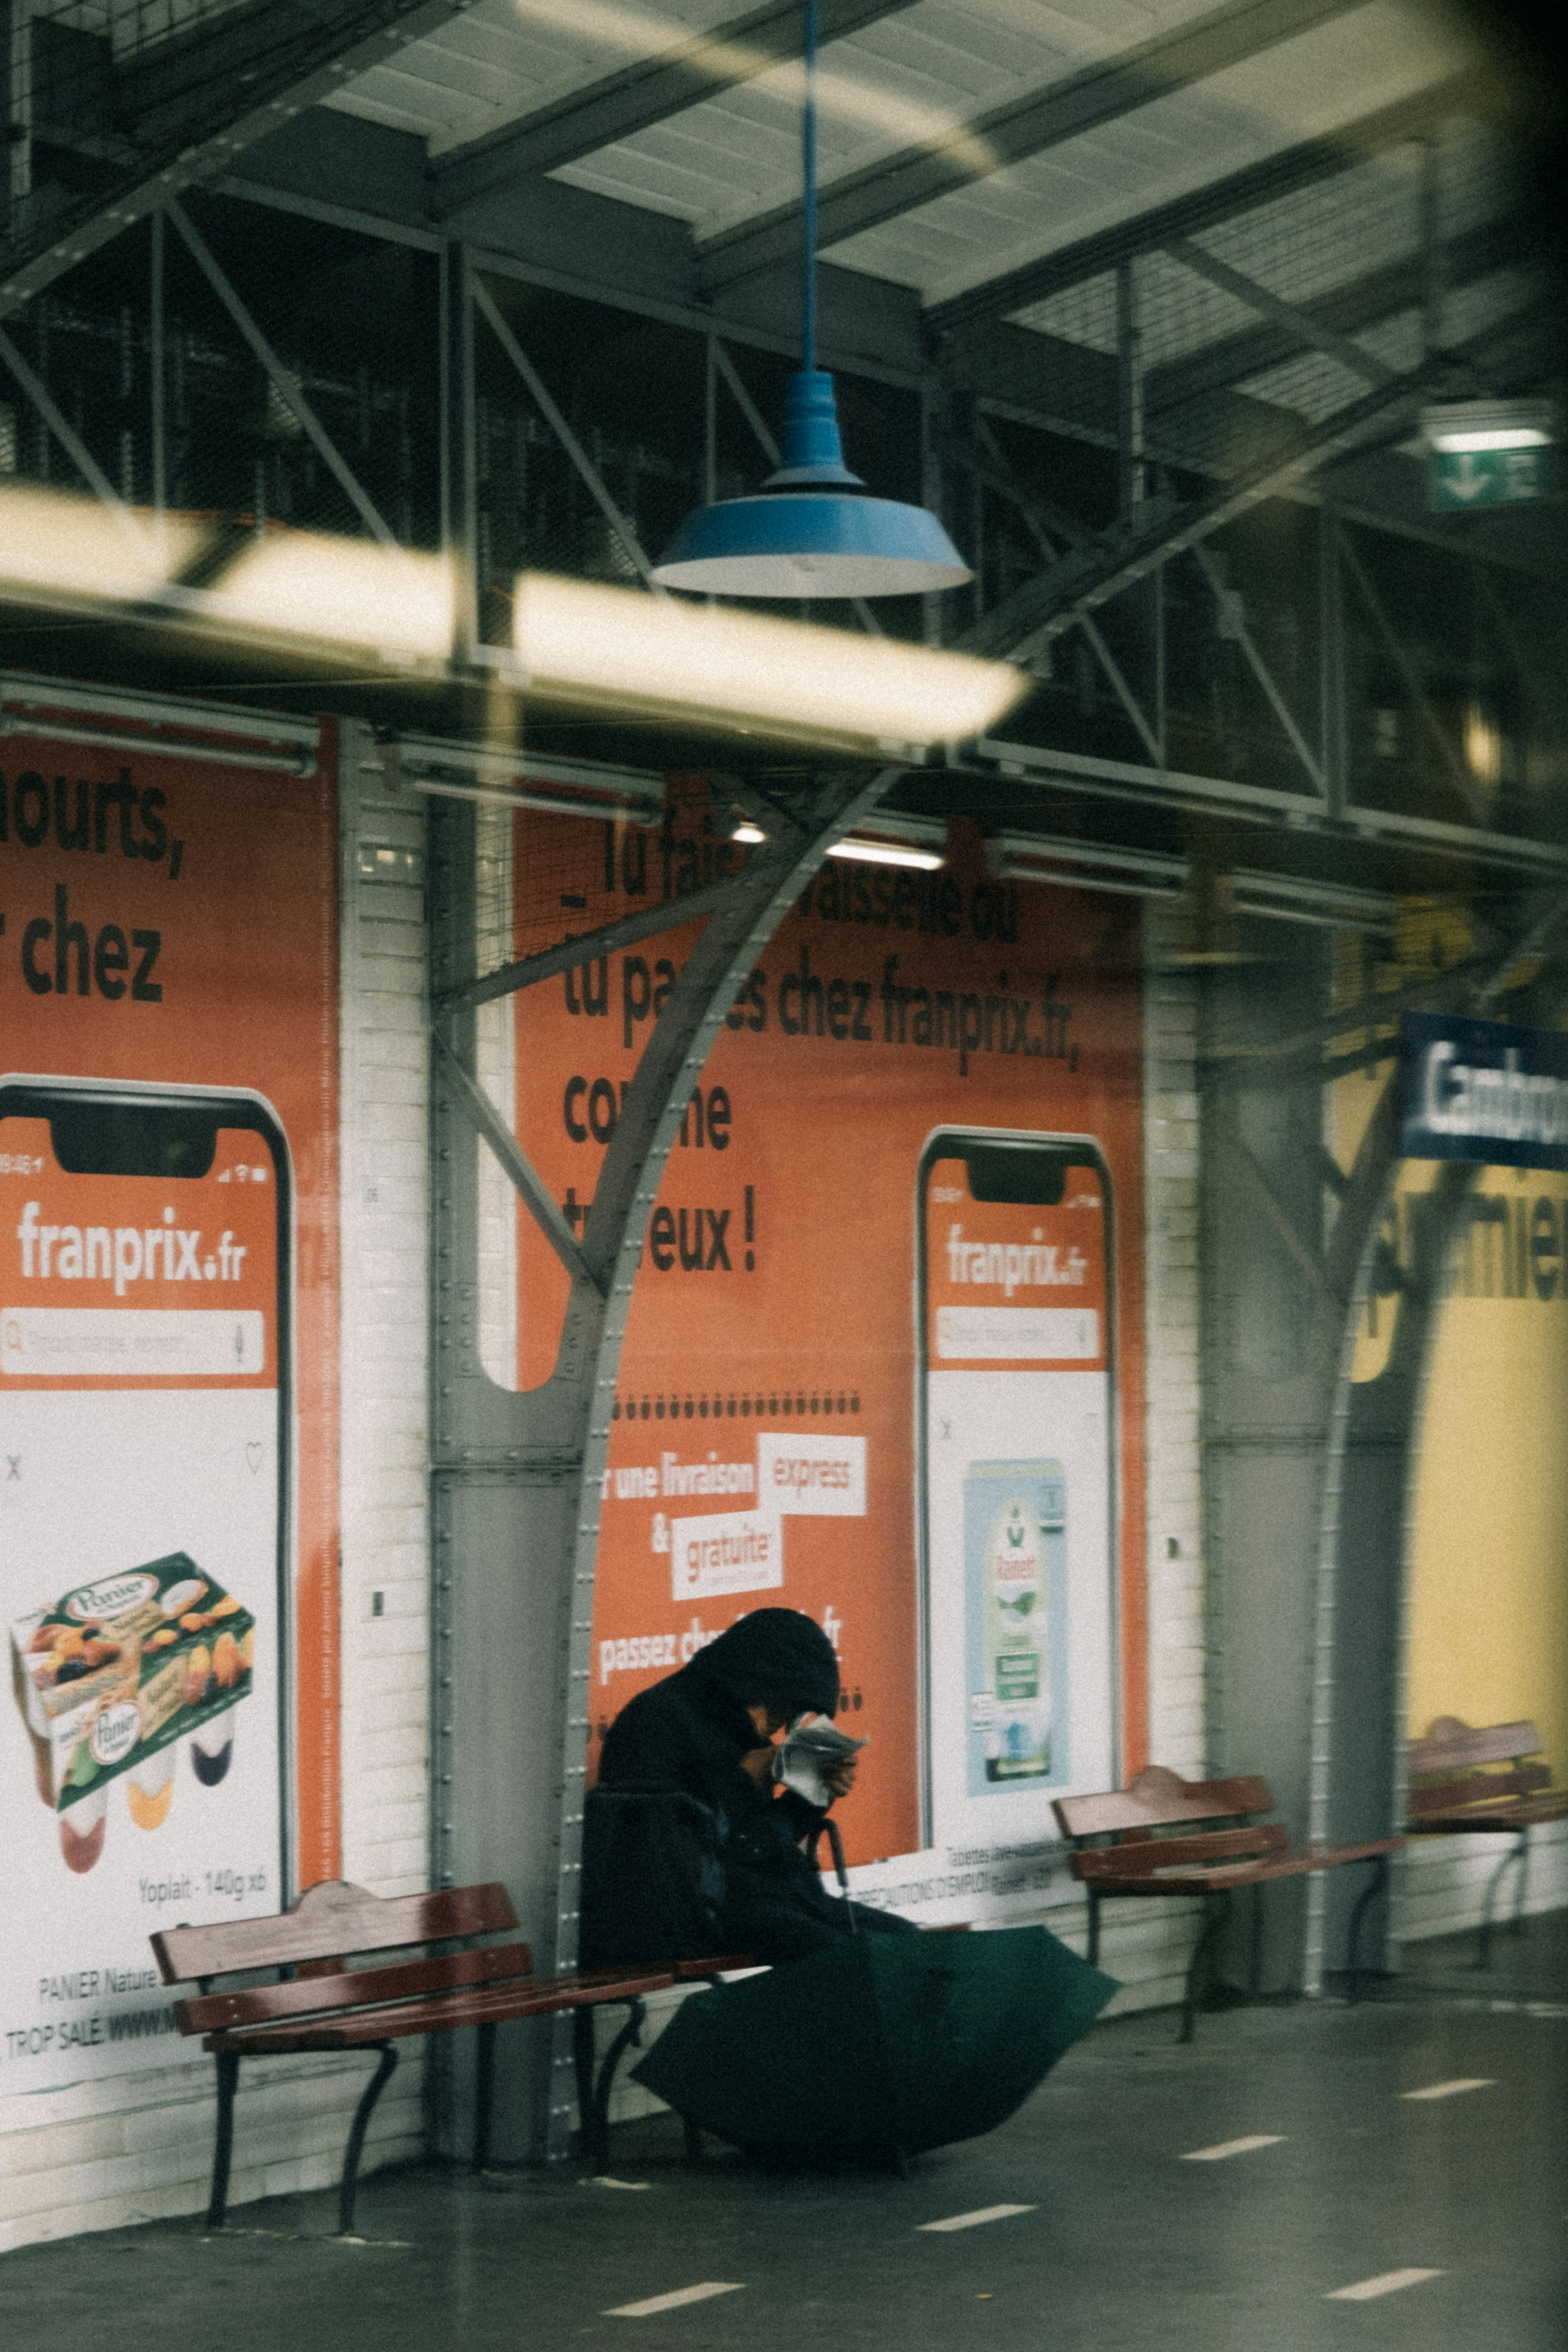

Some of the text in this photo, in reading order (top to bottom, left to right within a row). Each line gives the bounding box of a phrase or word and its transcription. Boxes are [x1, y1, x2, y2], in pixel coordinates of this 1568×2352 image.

[0, 767, 183, 880] ourts,
[21, 884, 162, 1003] chez
[778, 945, 872, 1041] chez
[880, 954, 1080, 1077] franprix.fr,
[17, 1201, 247, 1297] franprix.fr
[615, 1466, 658, 1500] une
[662, 1452, 755, 1497] livraison
[774, 1457, 851, 1500] express
[651, 1512, 771, 1583] & gratuite
[77, 1579, 145, 1612] Panier
[600, 1634, 677, 1686] passez
[139, 1873, 191, 1910] Yoplait
[206, 1870, 244, 1901] 140g
[38, 1968, 156, 2005] PANIER Nature
[6, 2025, 54, 2060] TROP
[58, 2010, 104, 2050] SALÉ
